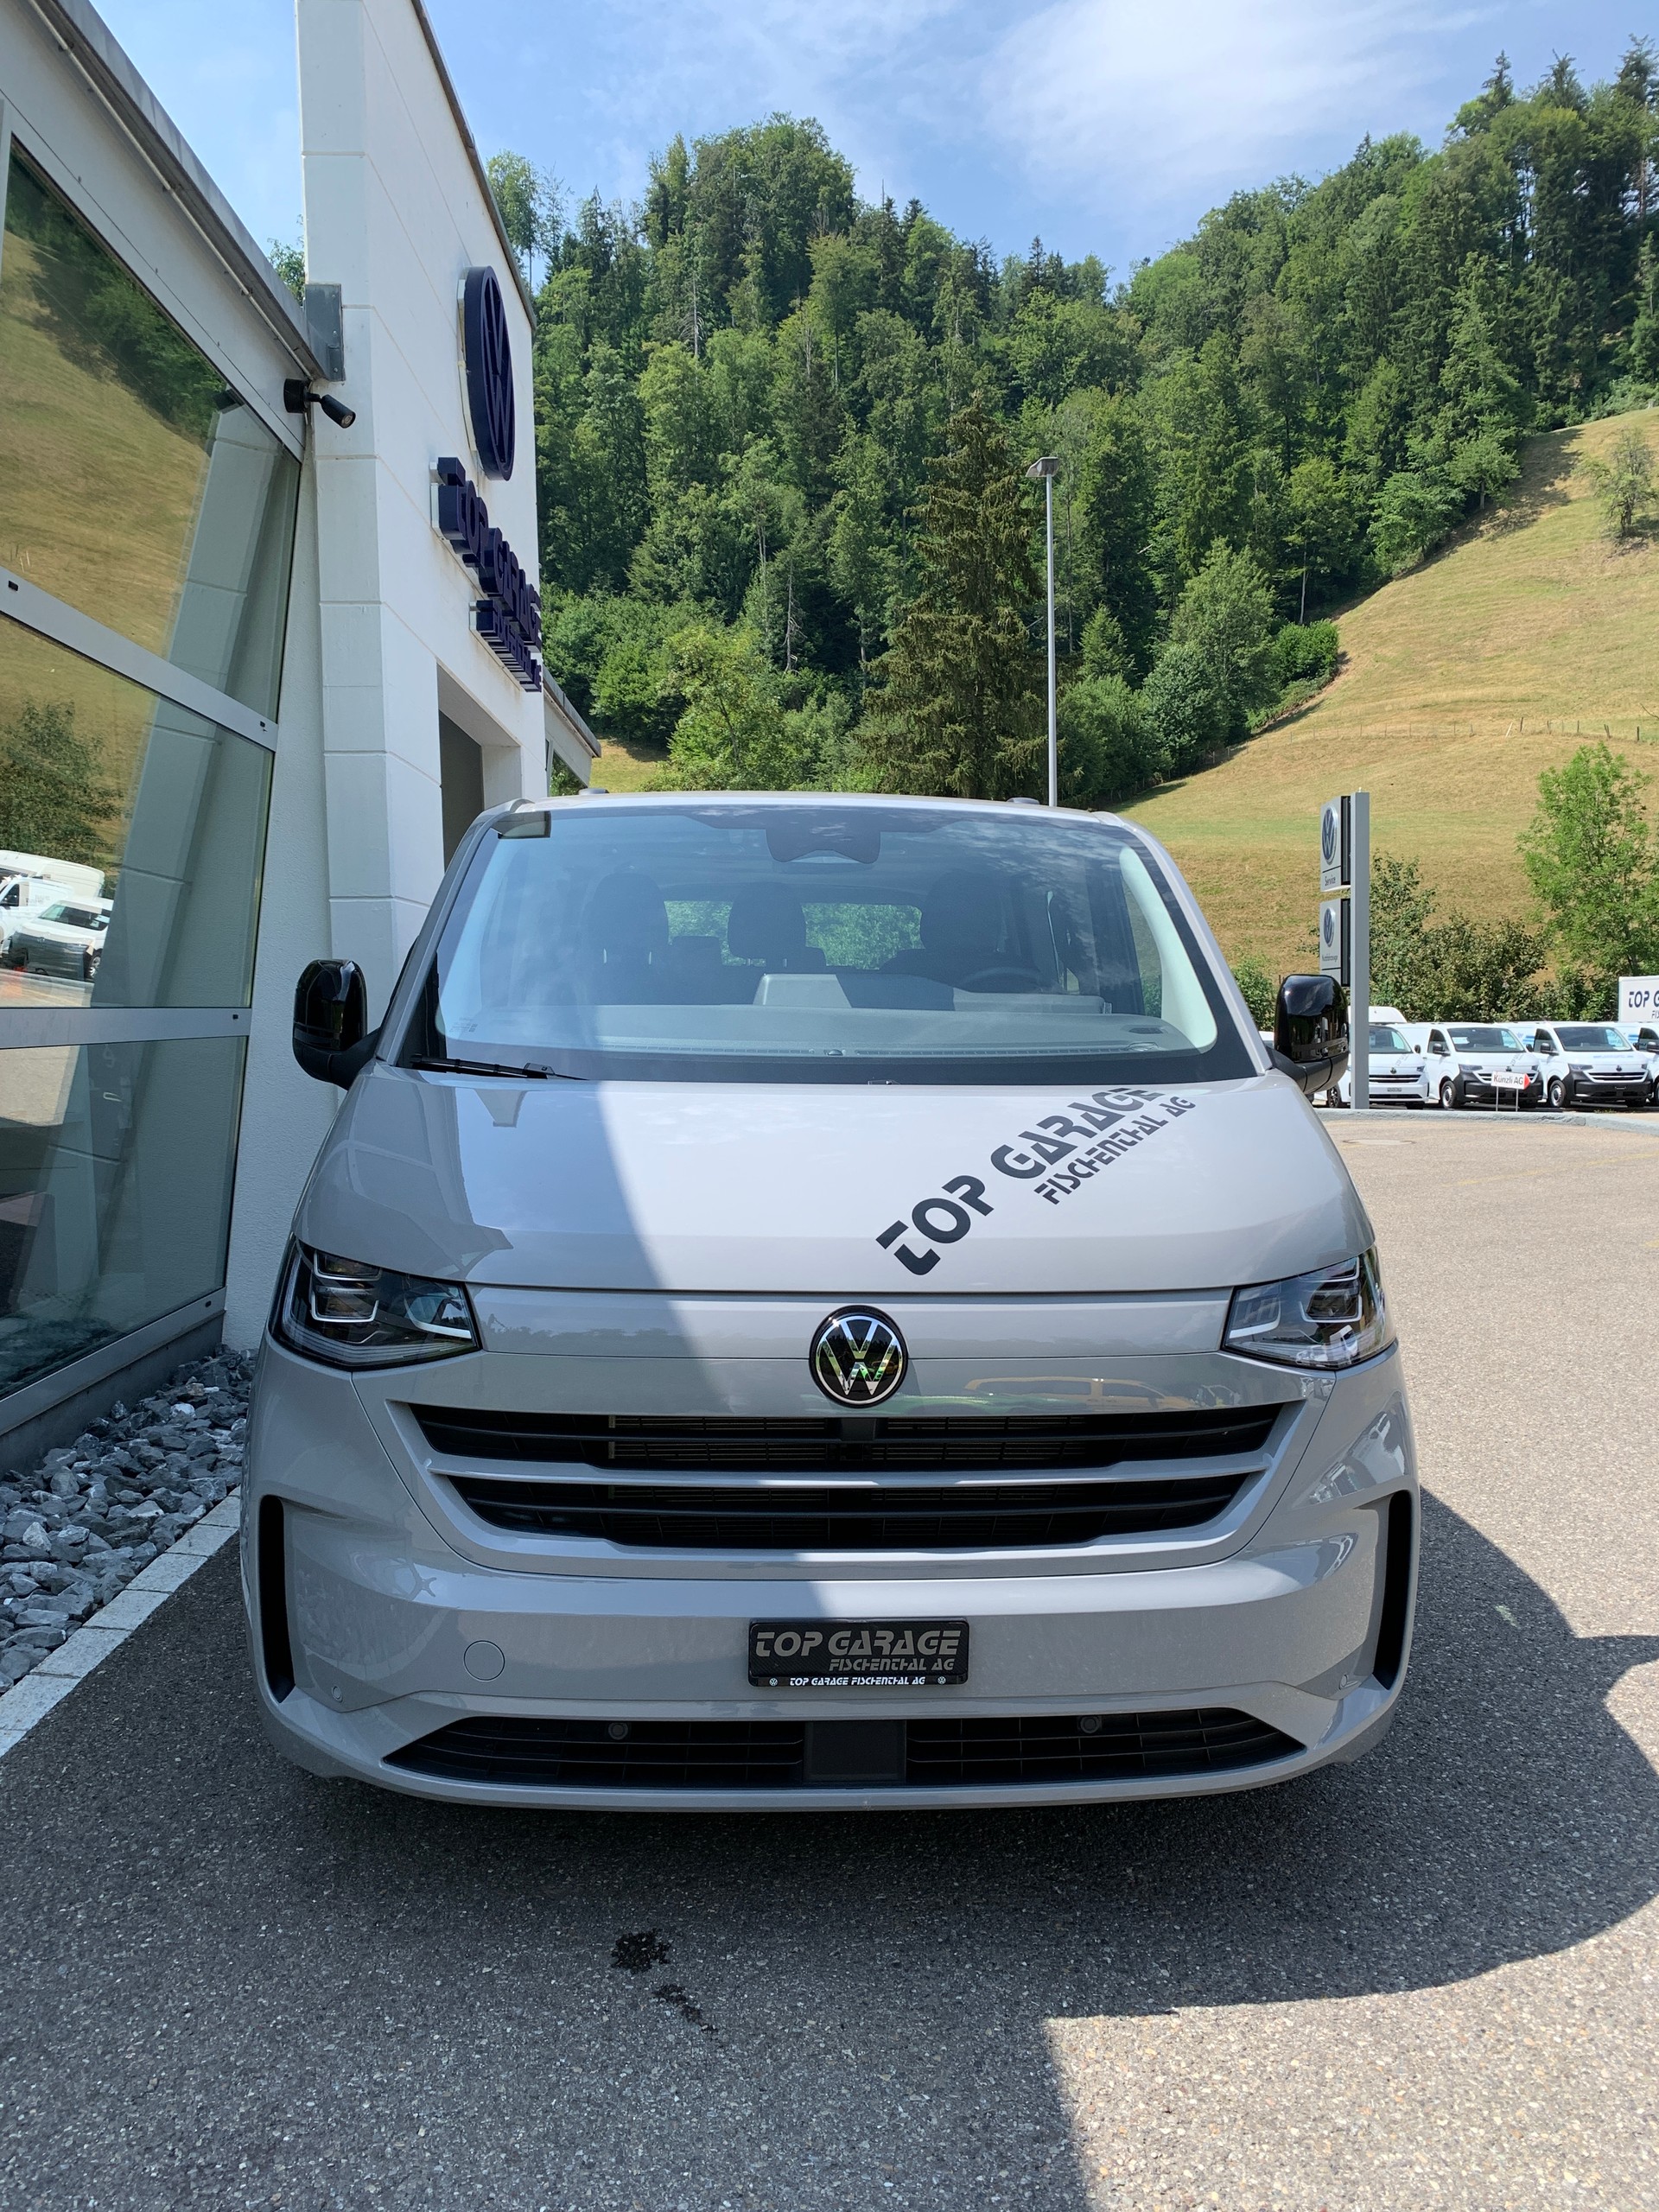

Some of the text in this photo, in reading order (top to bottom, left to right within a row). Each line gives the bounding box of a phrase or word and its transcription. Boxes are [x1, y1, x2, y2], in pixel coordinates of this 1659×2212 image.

[437, 457, 489, 568] TOP
[1628, 990, 1650, 1008] TOP
[1493, 1074, 1524, 1085] Künzli AG
[1033, 1096, 1197, 1205] FISCHENTHAL AG
[875, 1087, 1166, 1276] TOP GARAGE
[754, 1630, 962, 1657] TOP GARAGE
[829, 1658, 956, 1672] FISCHENTHAL AG
[789, 1676, 926, 1687] TOP GARAGE FISCHENTHAL AG
